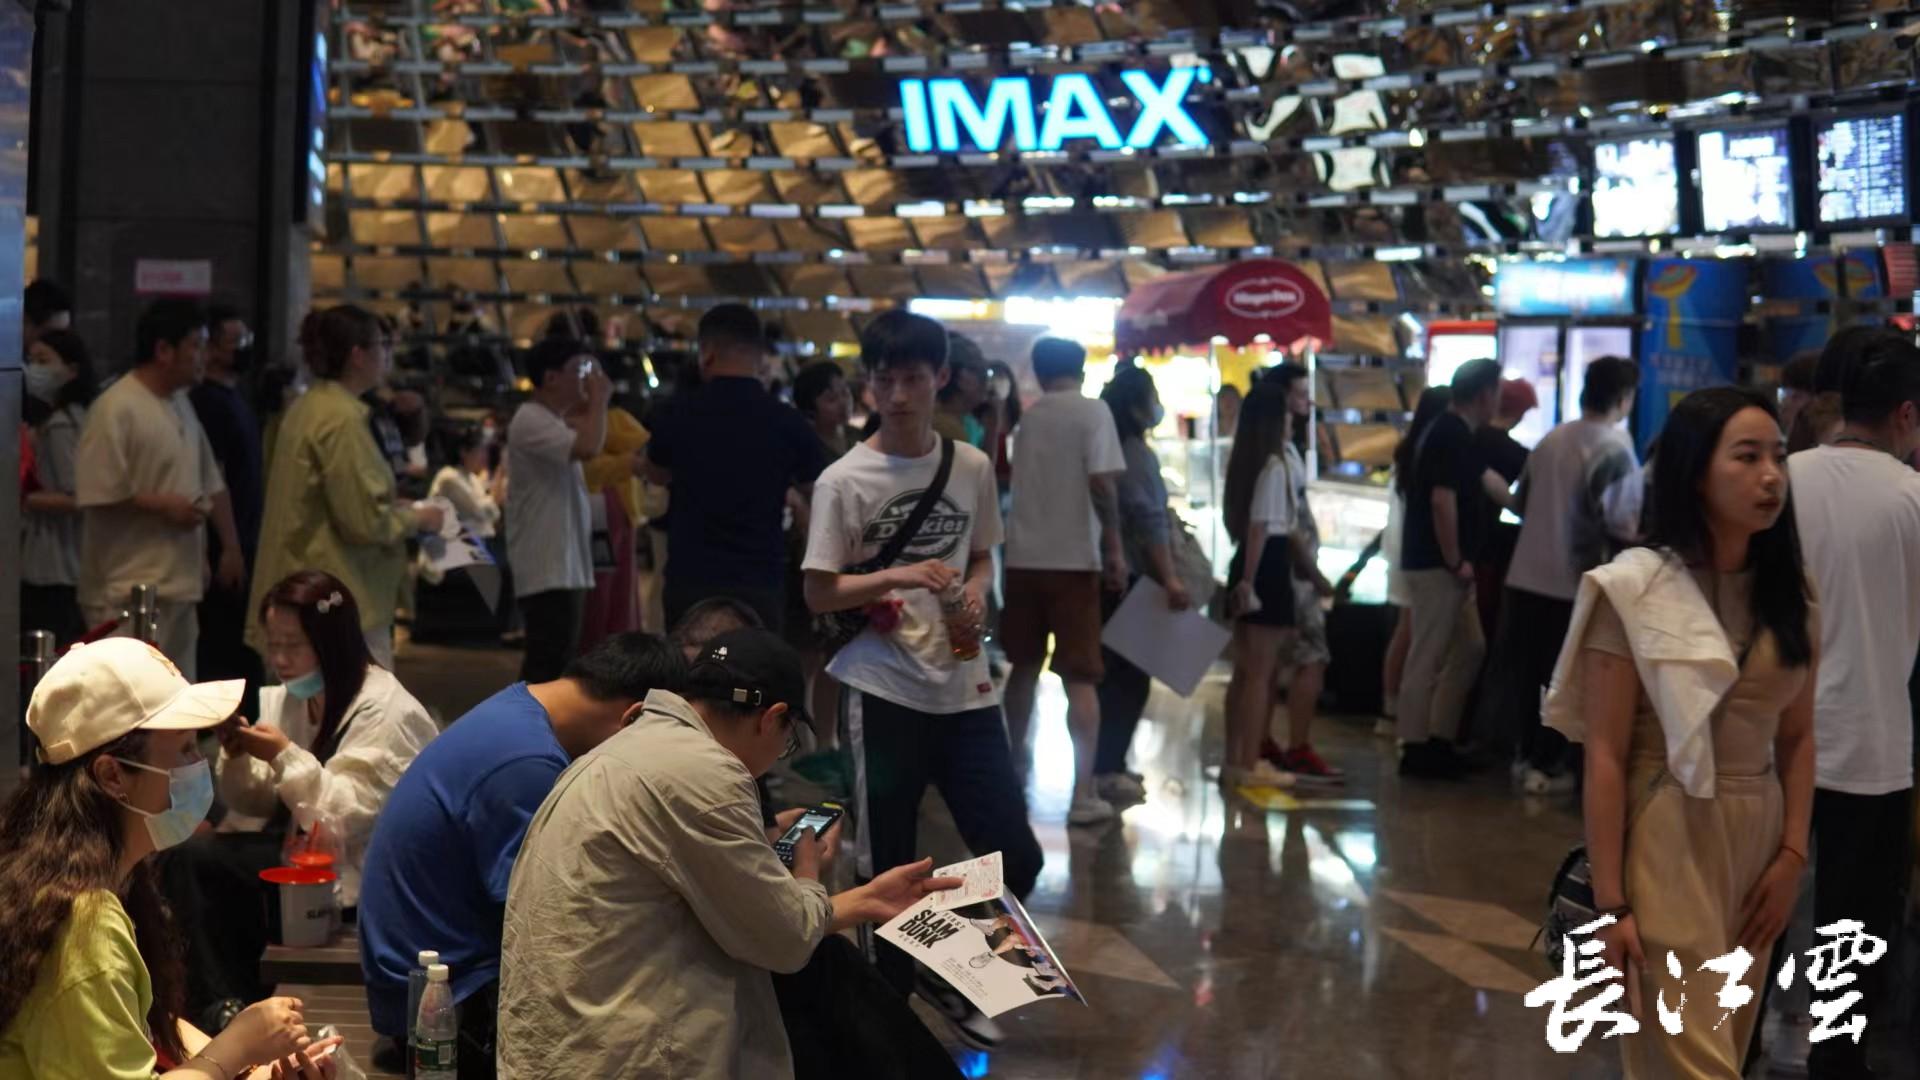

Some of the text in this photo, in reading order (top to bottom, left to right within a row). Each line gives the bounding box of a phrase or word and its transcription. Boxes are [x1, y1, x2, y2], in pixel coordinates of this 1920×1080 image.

[900, 66, 1209, 151] IMAX
[873, 517, 965, 539] Dkies
[897, 918, 944, 950] DUNK
[913, 909, 960, 941] SLAM
